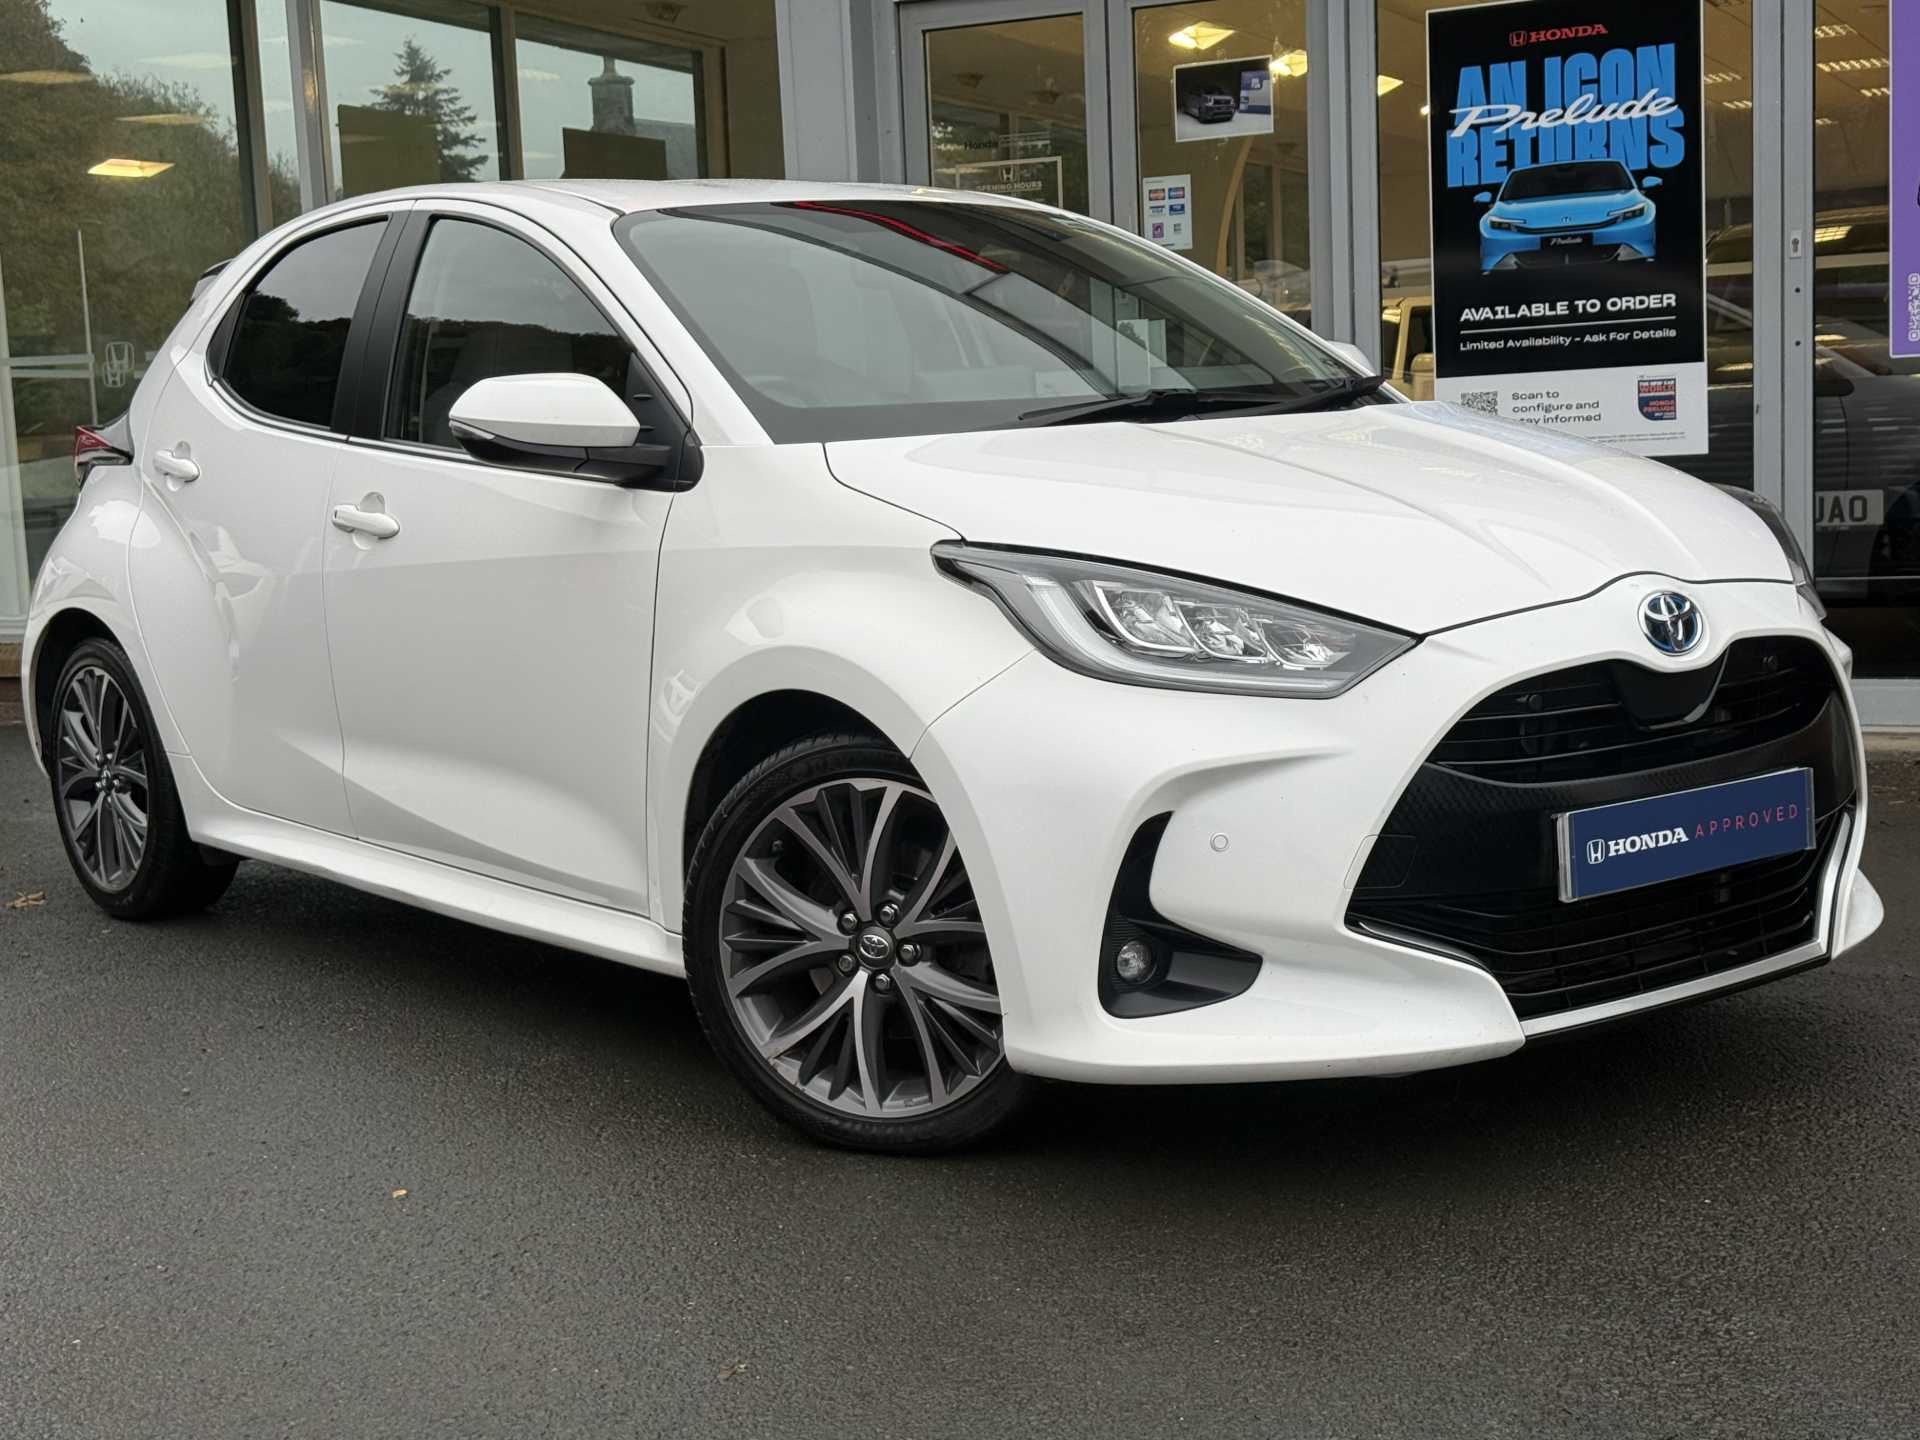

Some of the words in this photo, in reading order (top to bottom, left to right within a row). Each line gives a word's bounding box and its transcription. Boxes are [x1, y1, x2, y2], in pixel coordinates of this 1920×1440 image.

[1529, 24, 1608, 43] HONDA
[1454, 60, 1526, 126] AN
[1544, 43, 1676, 116] ICON
[1449, 88, 1679, 137] Prelude
[1447, 108, 1685, 188] RETURNS
[1014, 180, 1042, 190] HOURS
[1460, 301, 1569, 322] AVAILABLE
[1574, 299, 1601, 315] TO
[1606, 294, 1677, 312] ORDER
[1460, 339, 1505, 351] Limited
[1507, 334, 1572, 350] Availability
[1584, 332, 1607, 343] Ask
[1609, 330, 1630, 341] For
[1633, 327, 1677, 339] Details
[1512, 392, 1543, 400] Scan
[1546, 390, 1560, 399] to
[1512, 402, 1573, 413] configure
[1575, 400, 1600, 410] and
[1543, 413, 1601, 424] informed
[1608, 828, 1689, 857] HONDA
[1696, 804, 1798, 839] APPROVED
